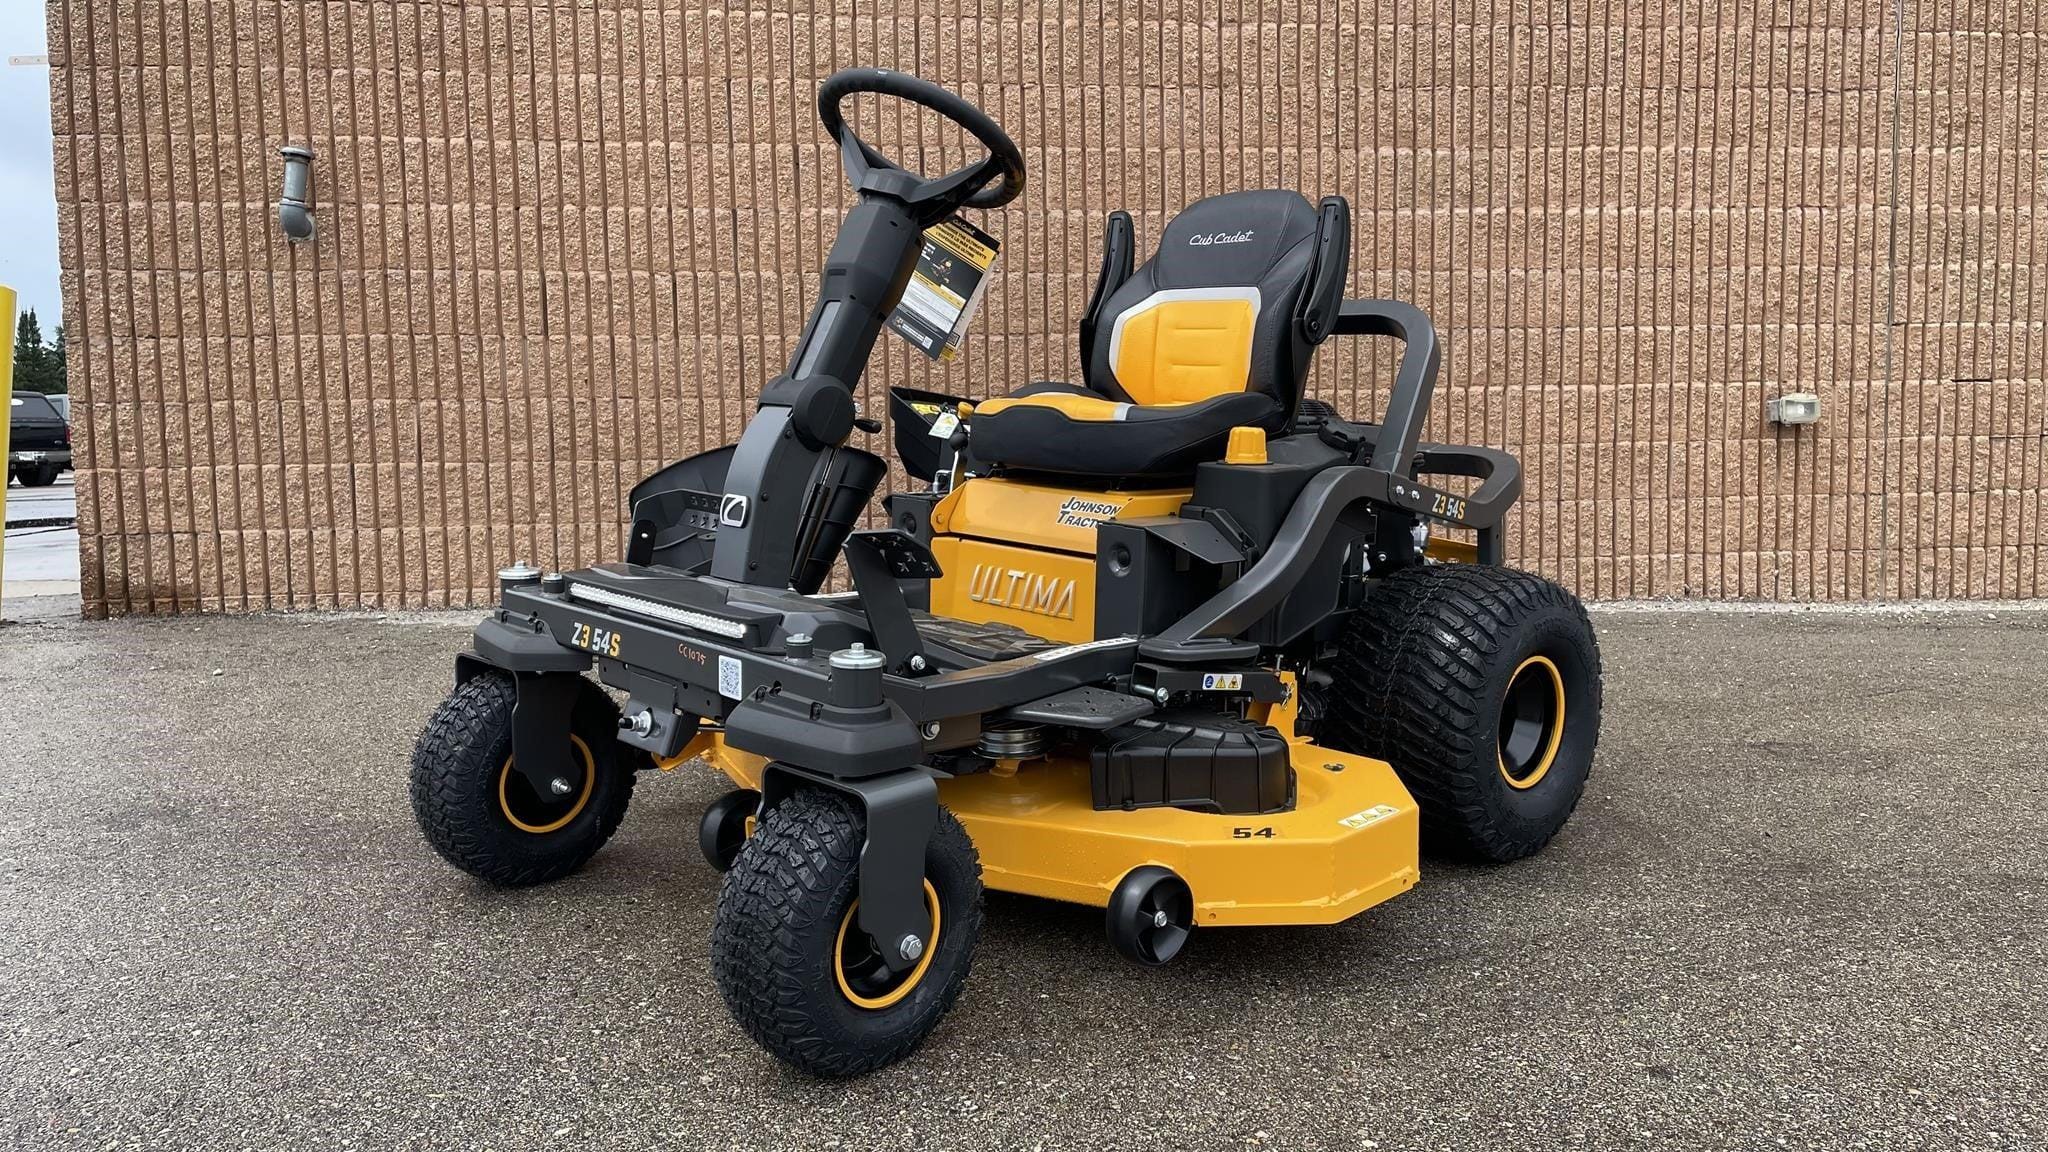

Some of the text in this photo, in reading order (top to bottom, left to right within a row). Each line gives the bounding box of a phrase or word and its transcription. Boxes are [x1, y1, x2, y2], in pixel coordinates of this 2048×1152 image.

[1189, 230, 1254, 245] Cub Cadet
[1062, 496, 1121, 515] JOHNSON
[1432, 493, 1466, 520] Z3 54S
[1057, 511, 1098, 528] TRACT
[969, 564, 1077, 621] ULTIMA
[571, 622, 621, 657] Z3 54S
[1232, 827, 1276, 839] 54
